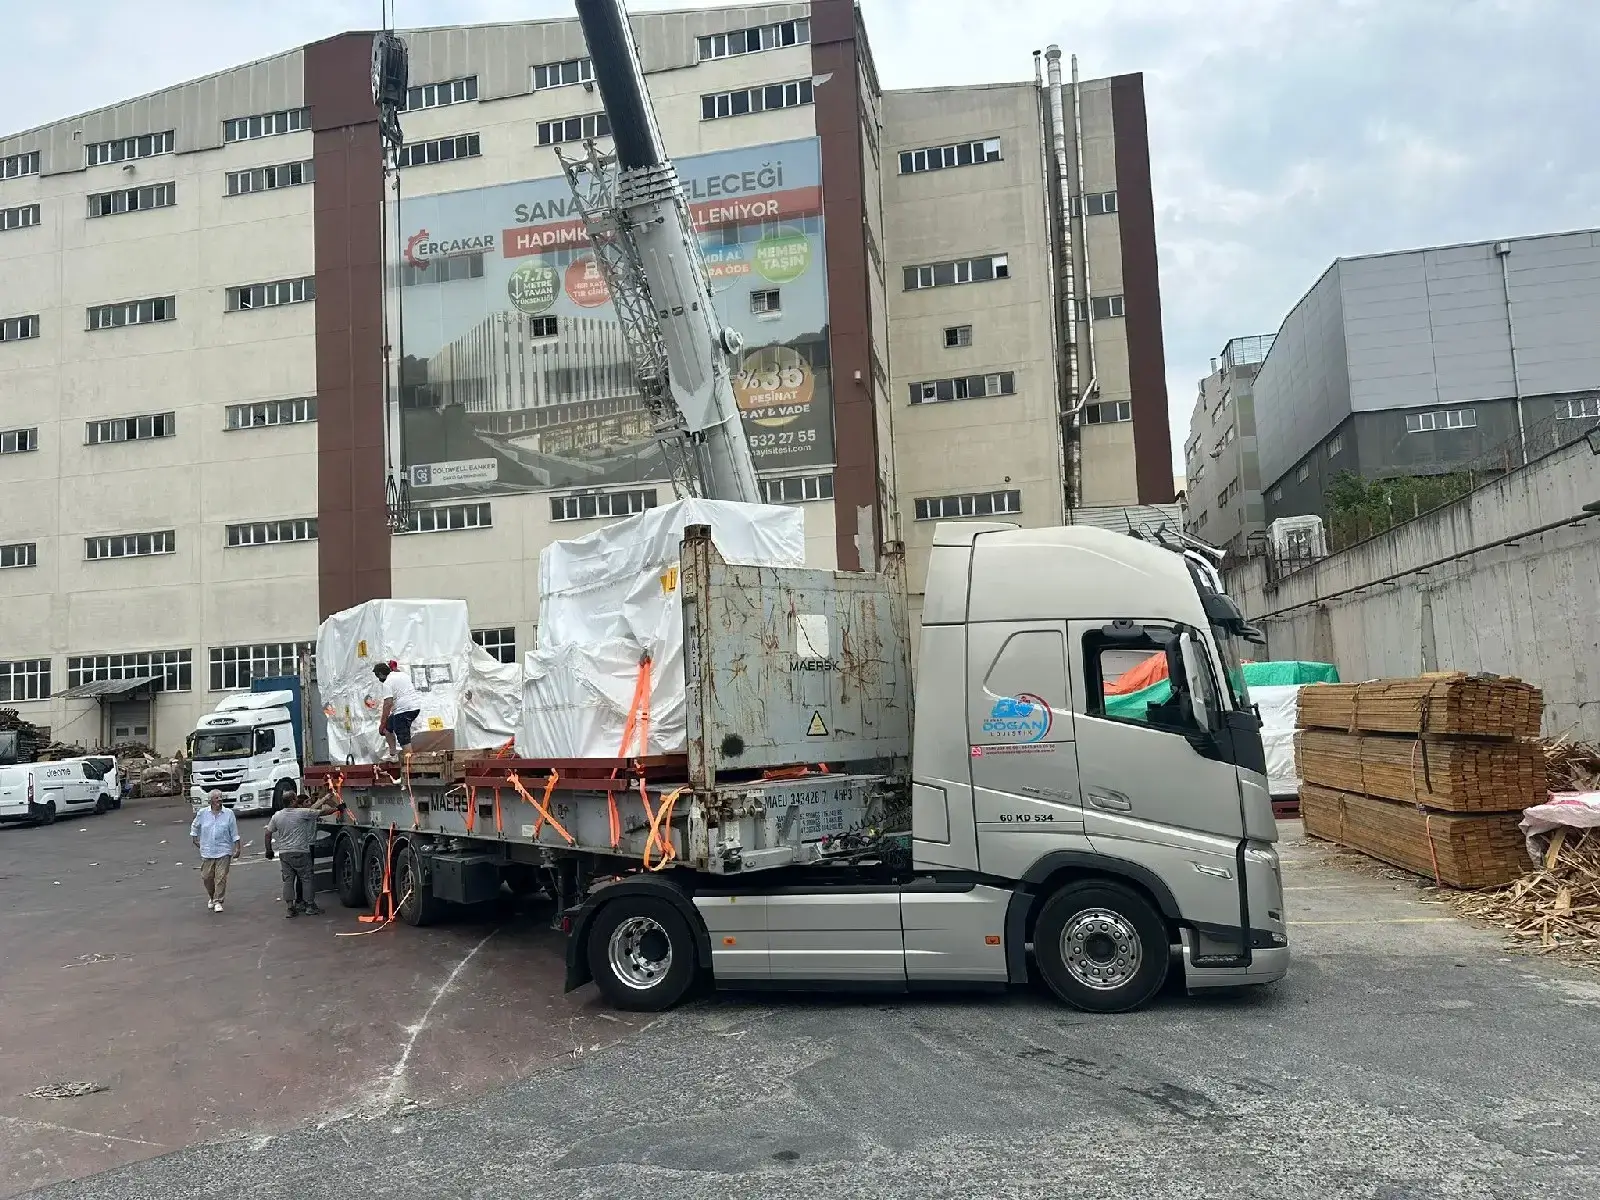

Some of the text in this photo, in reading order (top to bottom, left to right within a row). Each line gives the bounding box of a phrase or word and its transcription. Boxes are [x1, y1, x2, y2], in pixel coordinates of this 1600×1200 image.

[678, 160, 783, 200] ELECEĞİ
[419, 235, 494, 256] ERÇAKAR
[757, 242, 808, 258] HEMEN
[725, 262, 749, 274] ÖDE
[762, 254, 804, 270] TAŞIN
[523, 279, 552, 290] METRE
[524, 287, 553, 298] TAVAN
[736, 361, 804, 391] %35
[749, 390, 798, 405] PEŞİNAT
[749, 407, 766, 418] AY
[779, 404, 811, 416] VADE
[749, 429, 816, 447] 532 27 55
[469, 463, 496, 471] BANKER
[789, 660, 840, 671] MAERSK
[431, 792, 477, 813] MAERS
[1000, 814, 1054, 822] 60 KD 534
